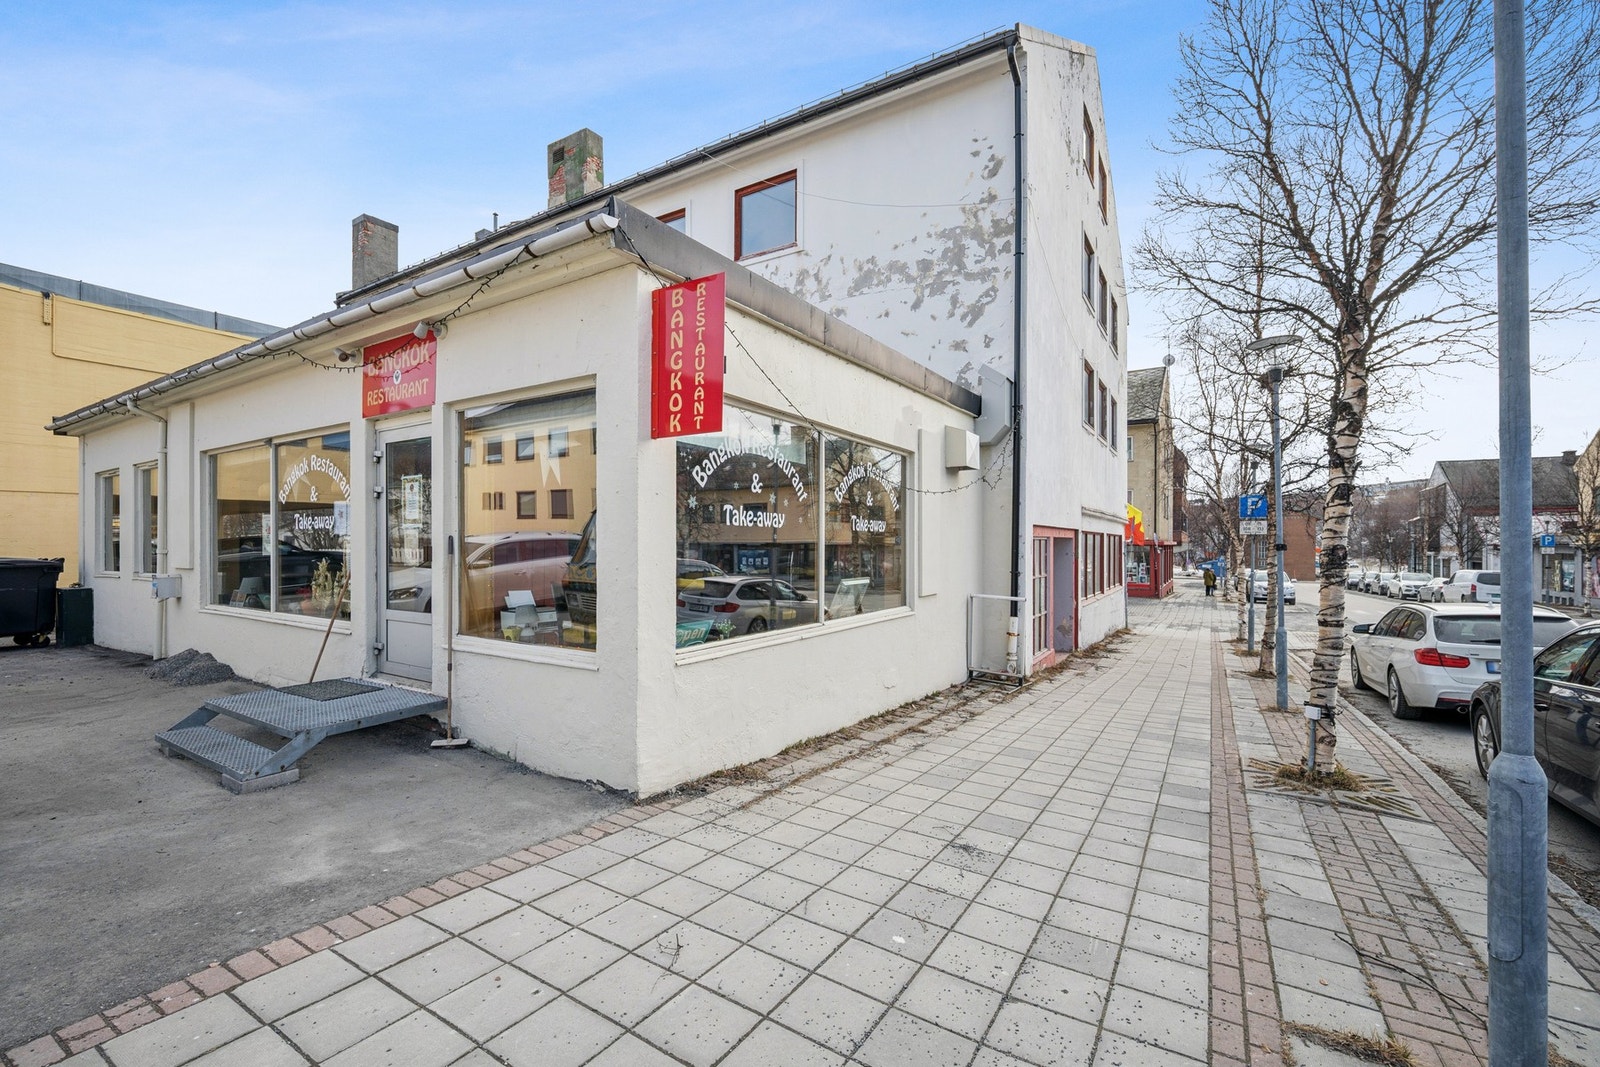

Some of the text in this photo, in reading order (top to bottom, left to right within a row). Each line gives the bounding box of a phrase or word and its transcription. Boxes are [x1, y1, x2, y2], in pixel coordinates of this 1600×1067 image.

[368, 341, 431, 377] BANGKOK
[669, 288, 684, 433] BANGKOK
[694, 282, 706, 430] RESTAURANT
[367, 378, 429, 407] RESTAURANT
[279, 457, 309, 504] Bangkok
[692, 437, 808, 502] Bangkok Restaurant
[310, 485, 318, 502] &
[751, 473, 763, 494] &
[834, 461, 899, 512] Bangkok Restaurant
[866, 491, 873, 506] &
[1247, 497, 1263, 515] P
[293, 513, 335, 530] Take-away
[723, 504, 785, 529] Take-away
[851, 515, 886, 533] Take-away
[1545, 536, 1553, 546] P
